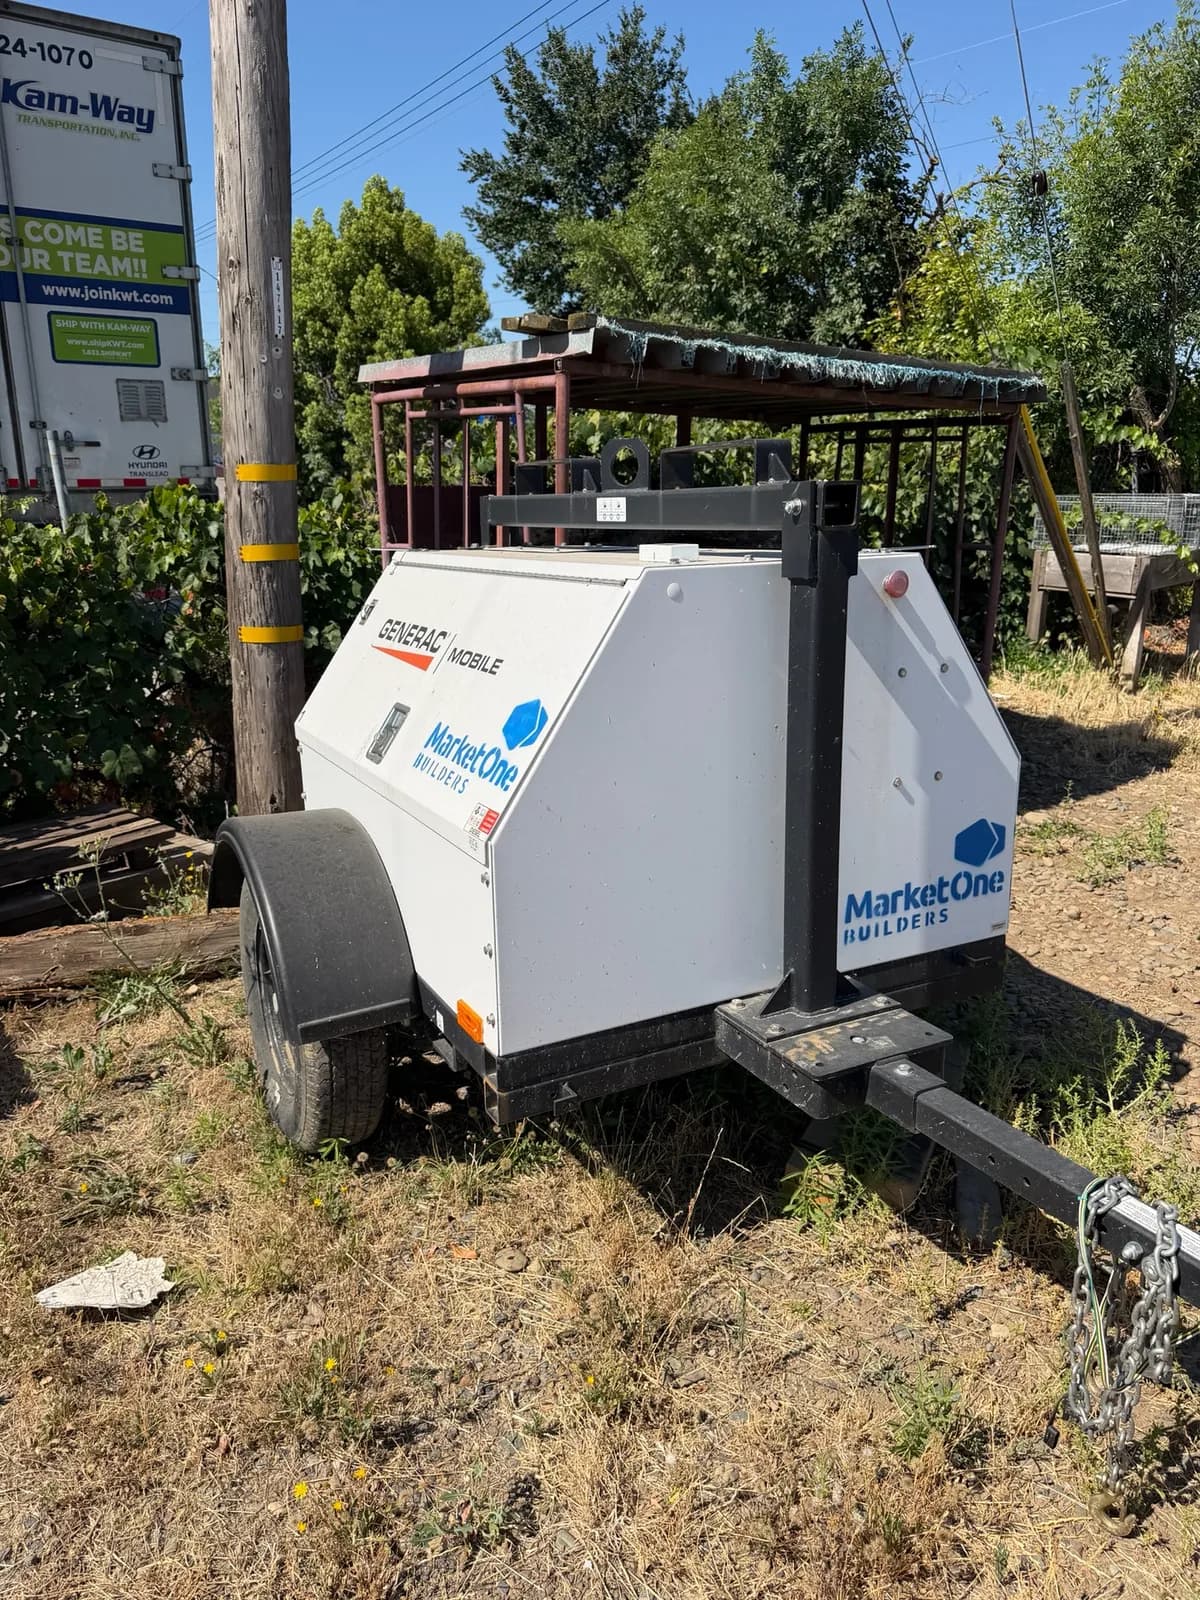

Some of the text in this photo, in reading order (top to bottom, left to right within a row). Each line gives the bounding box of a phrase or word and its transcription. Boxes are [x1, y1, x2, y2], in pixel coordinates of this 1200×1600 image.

[0, 34, 93, 70] 24-1070
[1, 78, 155, 133] Kam-Way
[17, 113, 140, 142] TRANSPORTATION, INC.
[24, 220, 104, 249] COME
[111, 229, 145, 253] BE
[57, 250, 148, 279] TEAM!!
[42, 284, 173, 305] www.joinkwt.com
[55, 319, 151, 333] SHIP WITH KAM-WAY
[128, 461, 168, 469] HYUNDAI
[378, 618, 504, 675] GENERAC MOBILE
[413, 752, 469, 794] BUILDERS
[424, 721, 519, 792] MarketOne
[844, 871, 1005, 924] MarketOne
[843, 908, 949, 946] BUILDERS
